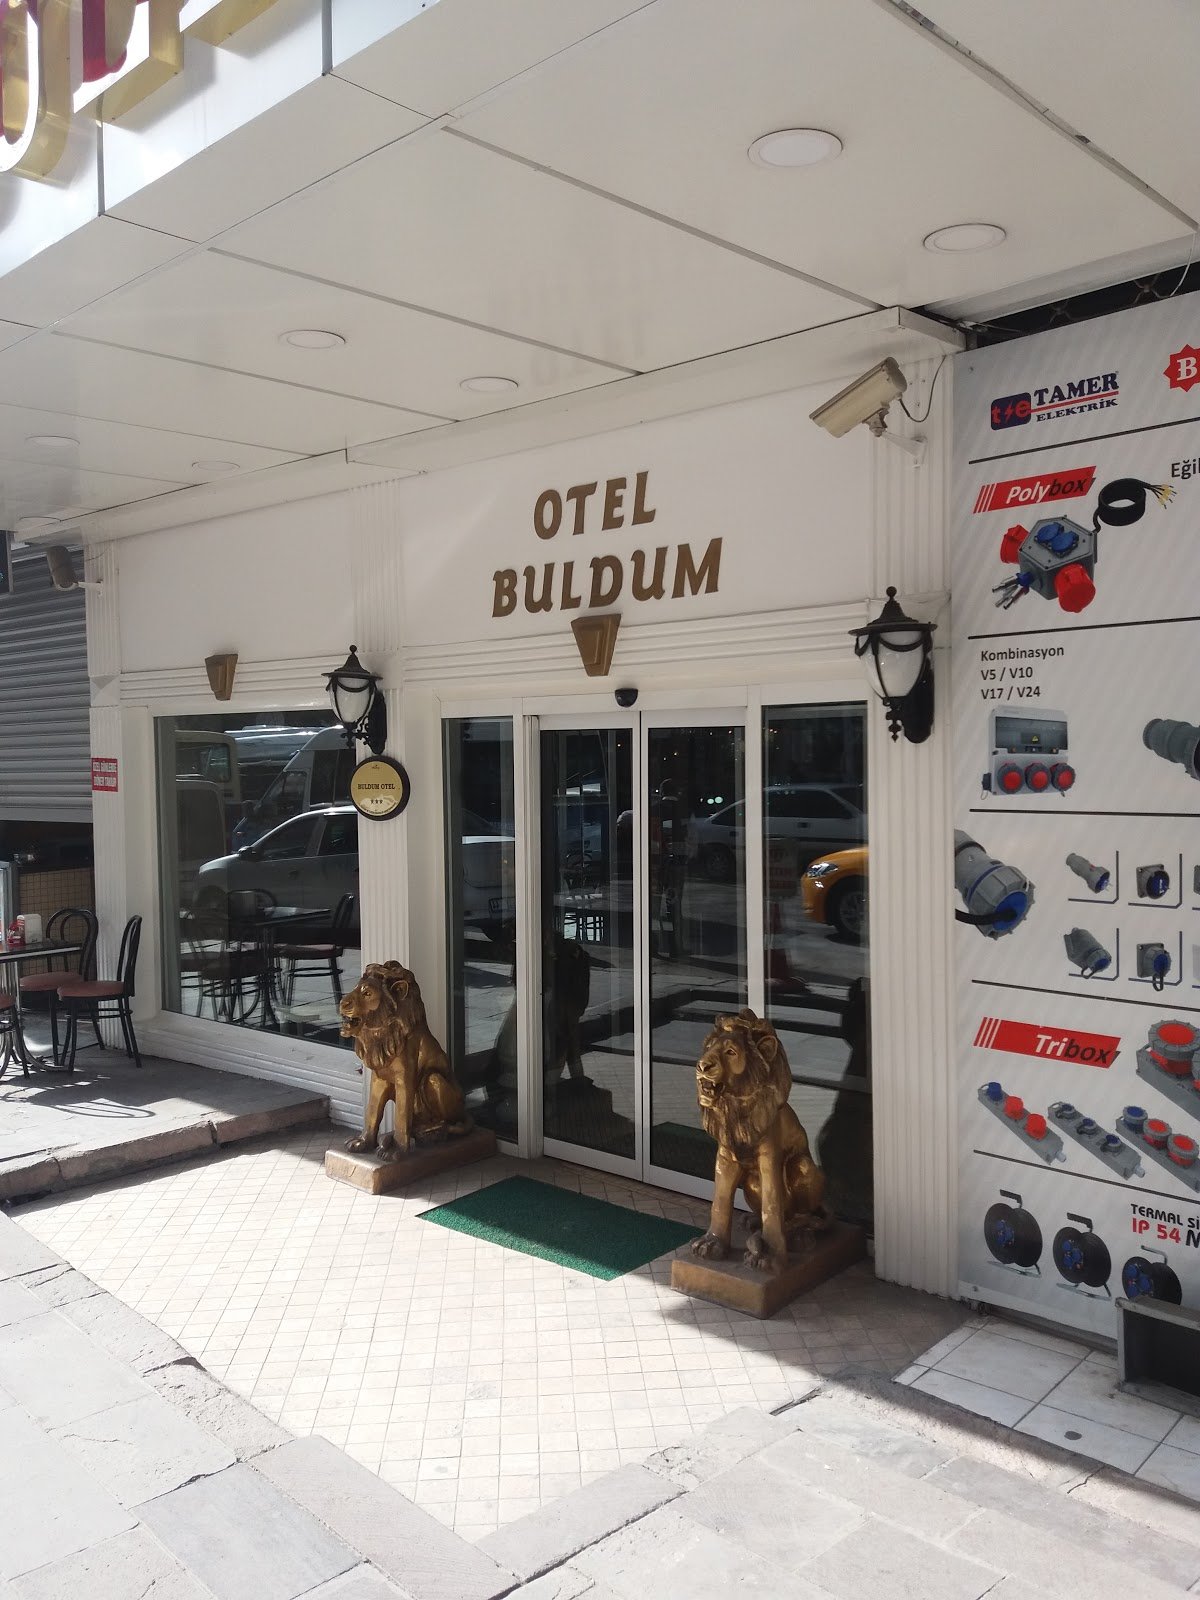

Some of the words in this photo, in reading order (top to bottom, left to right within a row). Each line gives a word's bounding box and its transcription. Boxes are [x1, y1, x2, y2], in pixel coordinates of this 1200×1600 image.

[1033, 372, 1120, 406] TAMER
[1036, 398, 1118, 422] ELEKTRİK
[1005, 478, 1088, 504] Polybox
[533, 470, 656, 540] OTEL
[492, 537, 723, 618] BULDUM
[981, 647, 1064, 661] Kombinasyon
[981, 669, 996, 681] V5
[1000, 667, 1006, 681] /
[1009, 666, 1033, 679] V10
[981, 688, 1004, 700] V17
[1007, 686, 1013, 701] /
[1017, 686, 1041, 698] V24
[1035, 1034, 1111, 1064] Tribox
[1130, 1203, 1183, 1226] TERMAL
[1132, 1217, 1150, 1234] IP
[1157, 1223, 1181, 1244] 54
